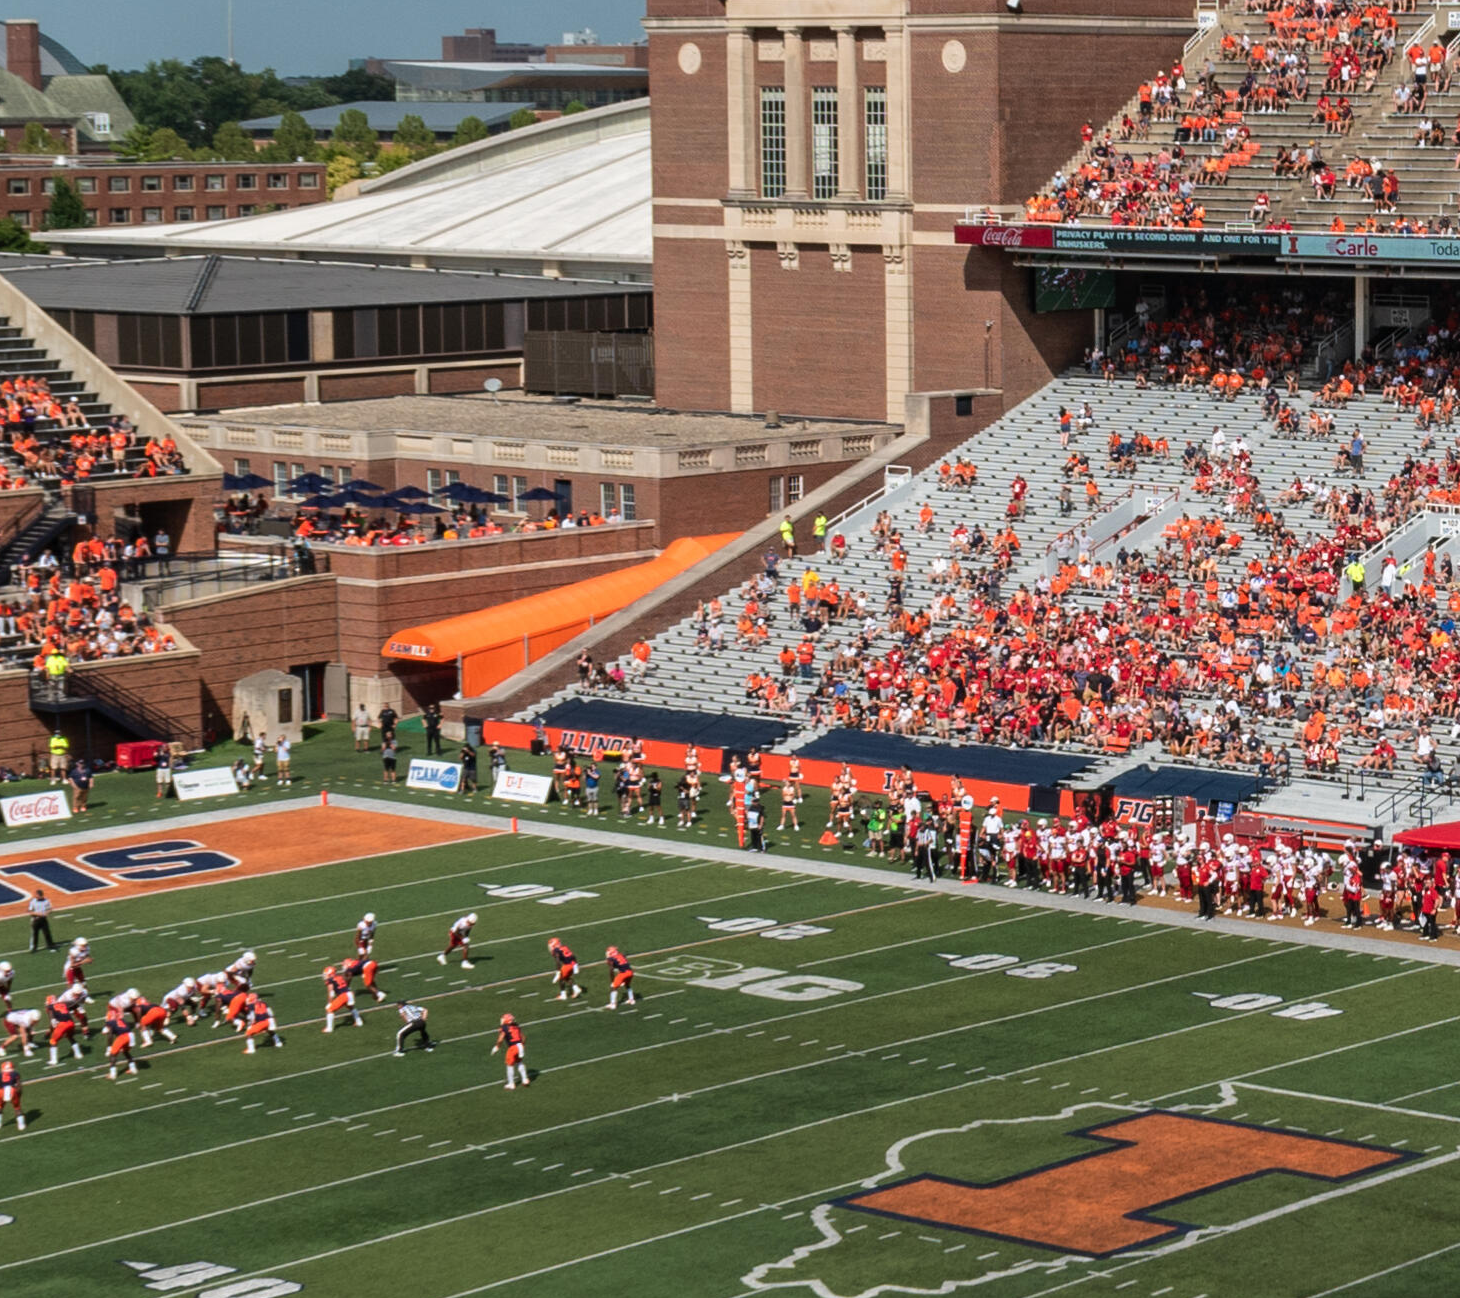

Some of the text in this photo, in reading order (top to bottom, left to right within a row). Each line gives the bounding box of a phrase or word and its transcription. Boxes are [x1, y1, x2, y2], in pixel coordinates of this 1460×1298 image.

[1056, 230, 1280, 245] PRIVACY PLAY IT'S SECOND DOWN AND ONE FOR THE
[1335, 238, 1378, 256] Carle
[411, 765, 441, 783] TEAM
[482, 883, 601, 907] 10
[946, 953, 1079, 981] 30
[1208, 991, 1344, 1023] 40
